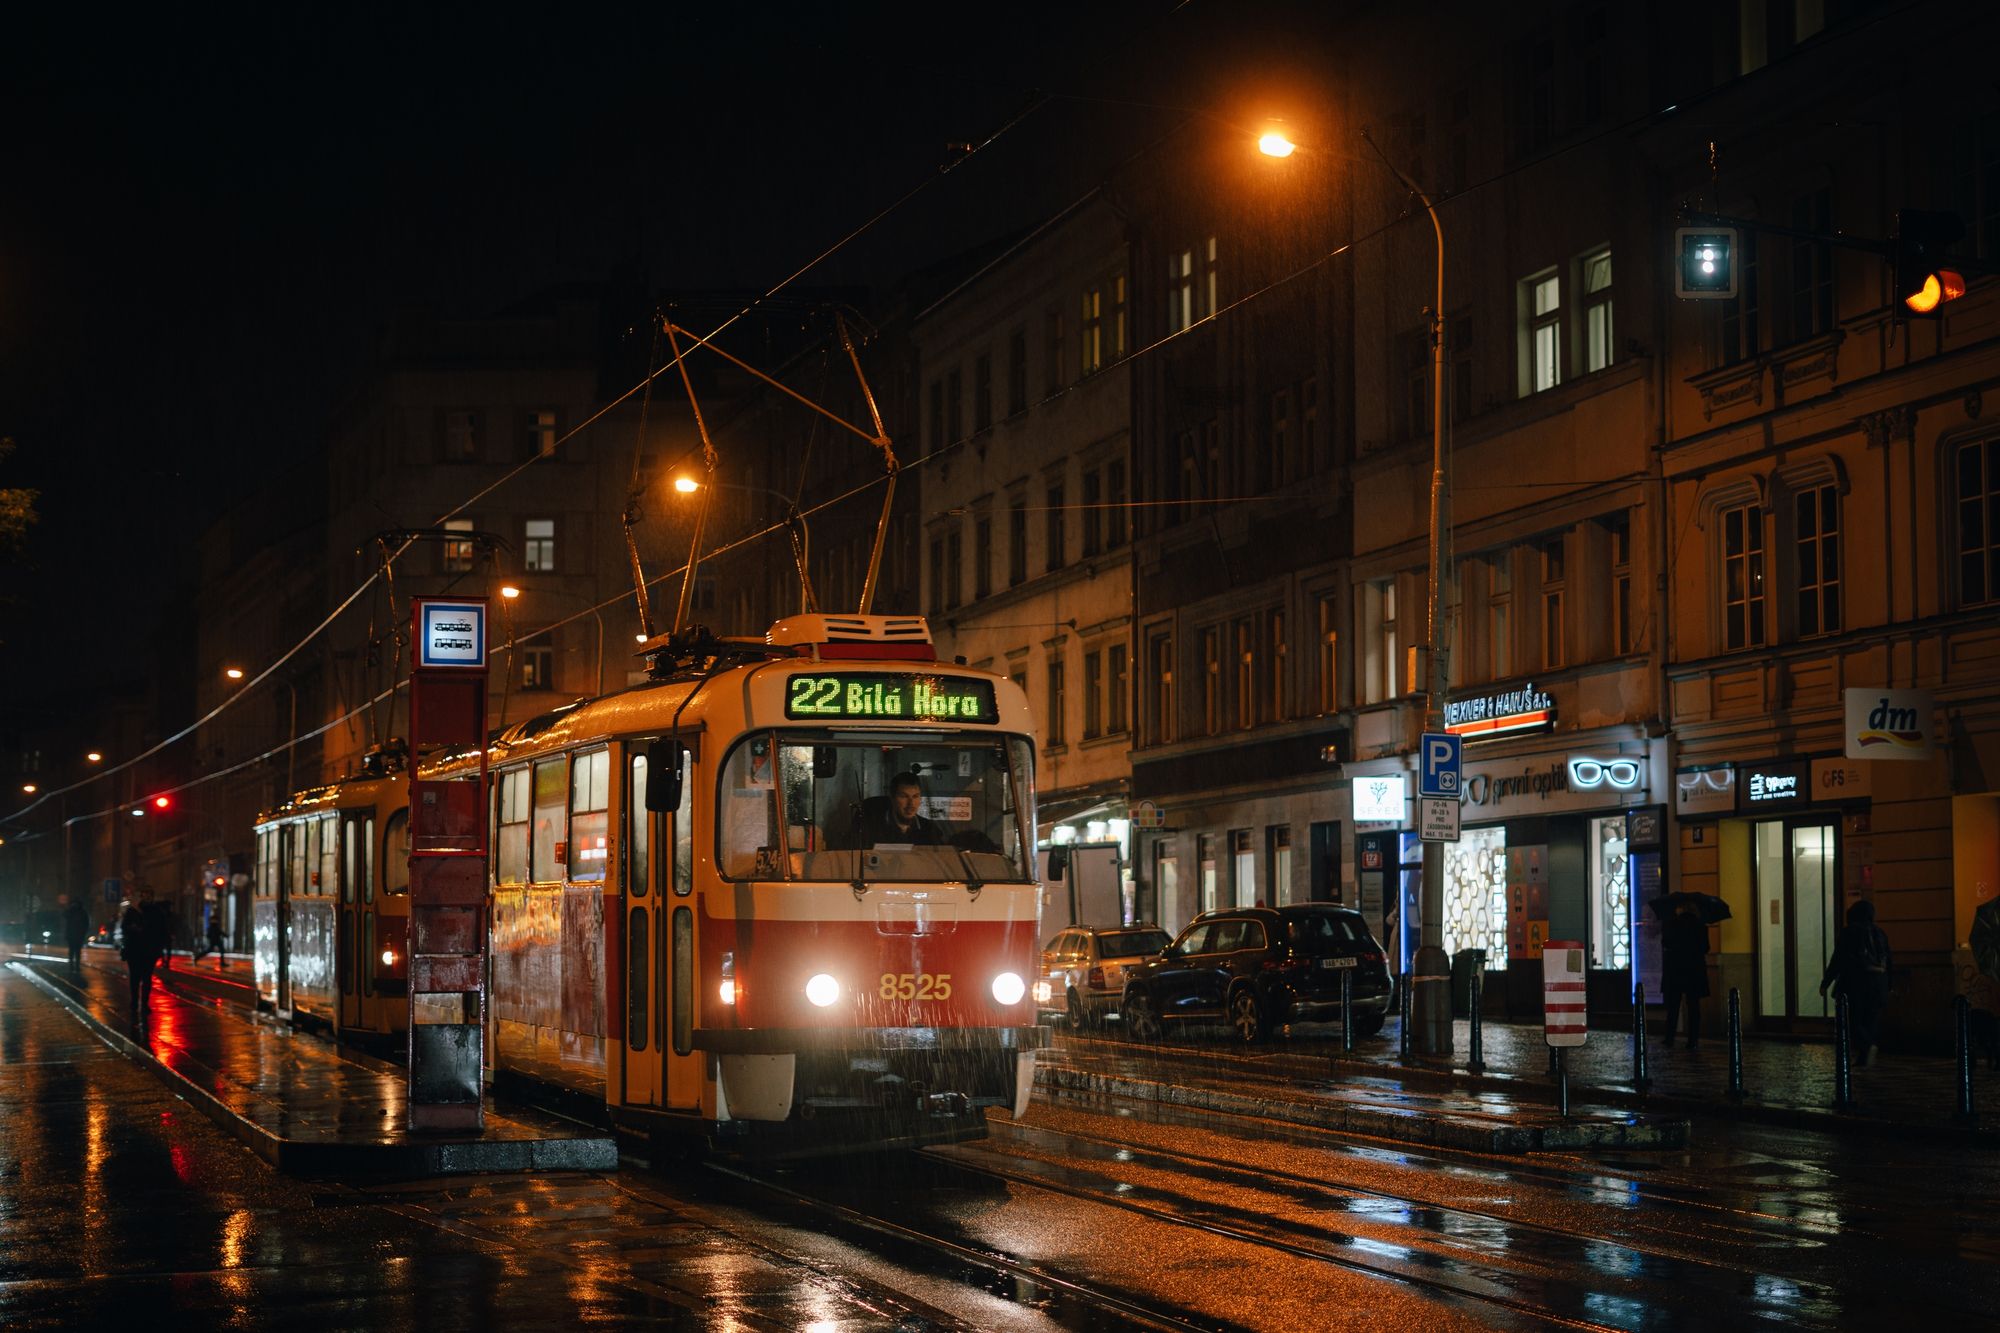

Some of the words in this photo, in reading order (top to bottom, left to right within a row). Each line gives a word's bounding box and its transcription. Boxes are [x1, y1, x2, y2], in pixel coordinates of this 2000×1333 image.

[792, 678, 841, 713] 22
[847, 683, 901, 714] Bílá
[914, 685, 978, 716] Hora
[1488, 696, 1494, 718] &
[1496, 682, 1533, 716] HANUŠ
[1533, 692, 1551, 710] a.s.
[1869, 698, 1917, 730] dm
[1430, 741, 1453, 776] P
[880, 973, 952, 1001] 8525
